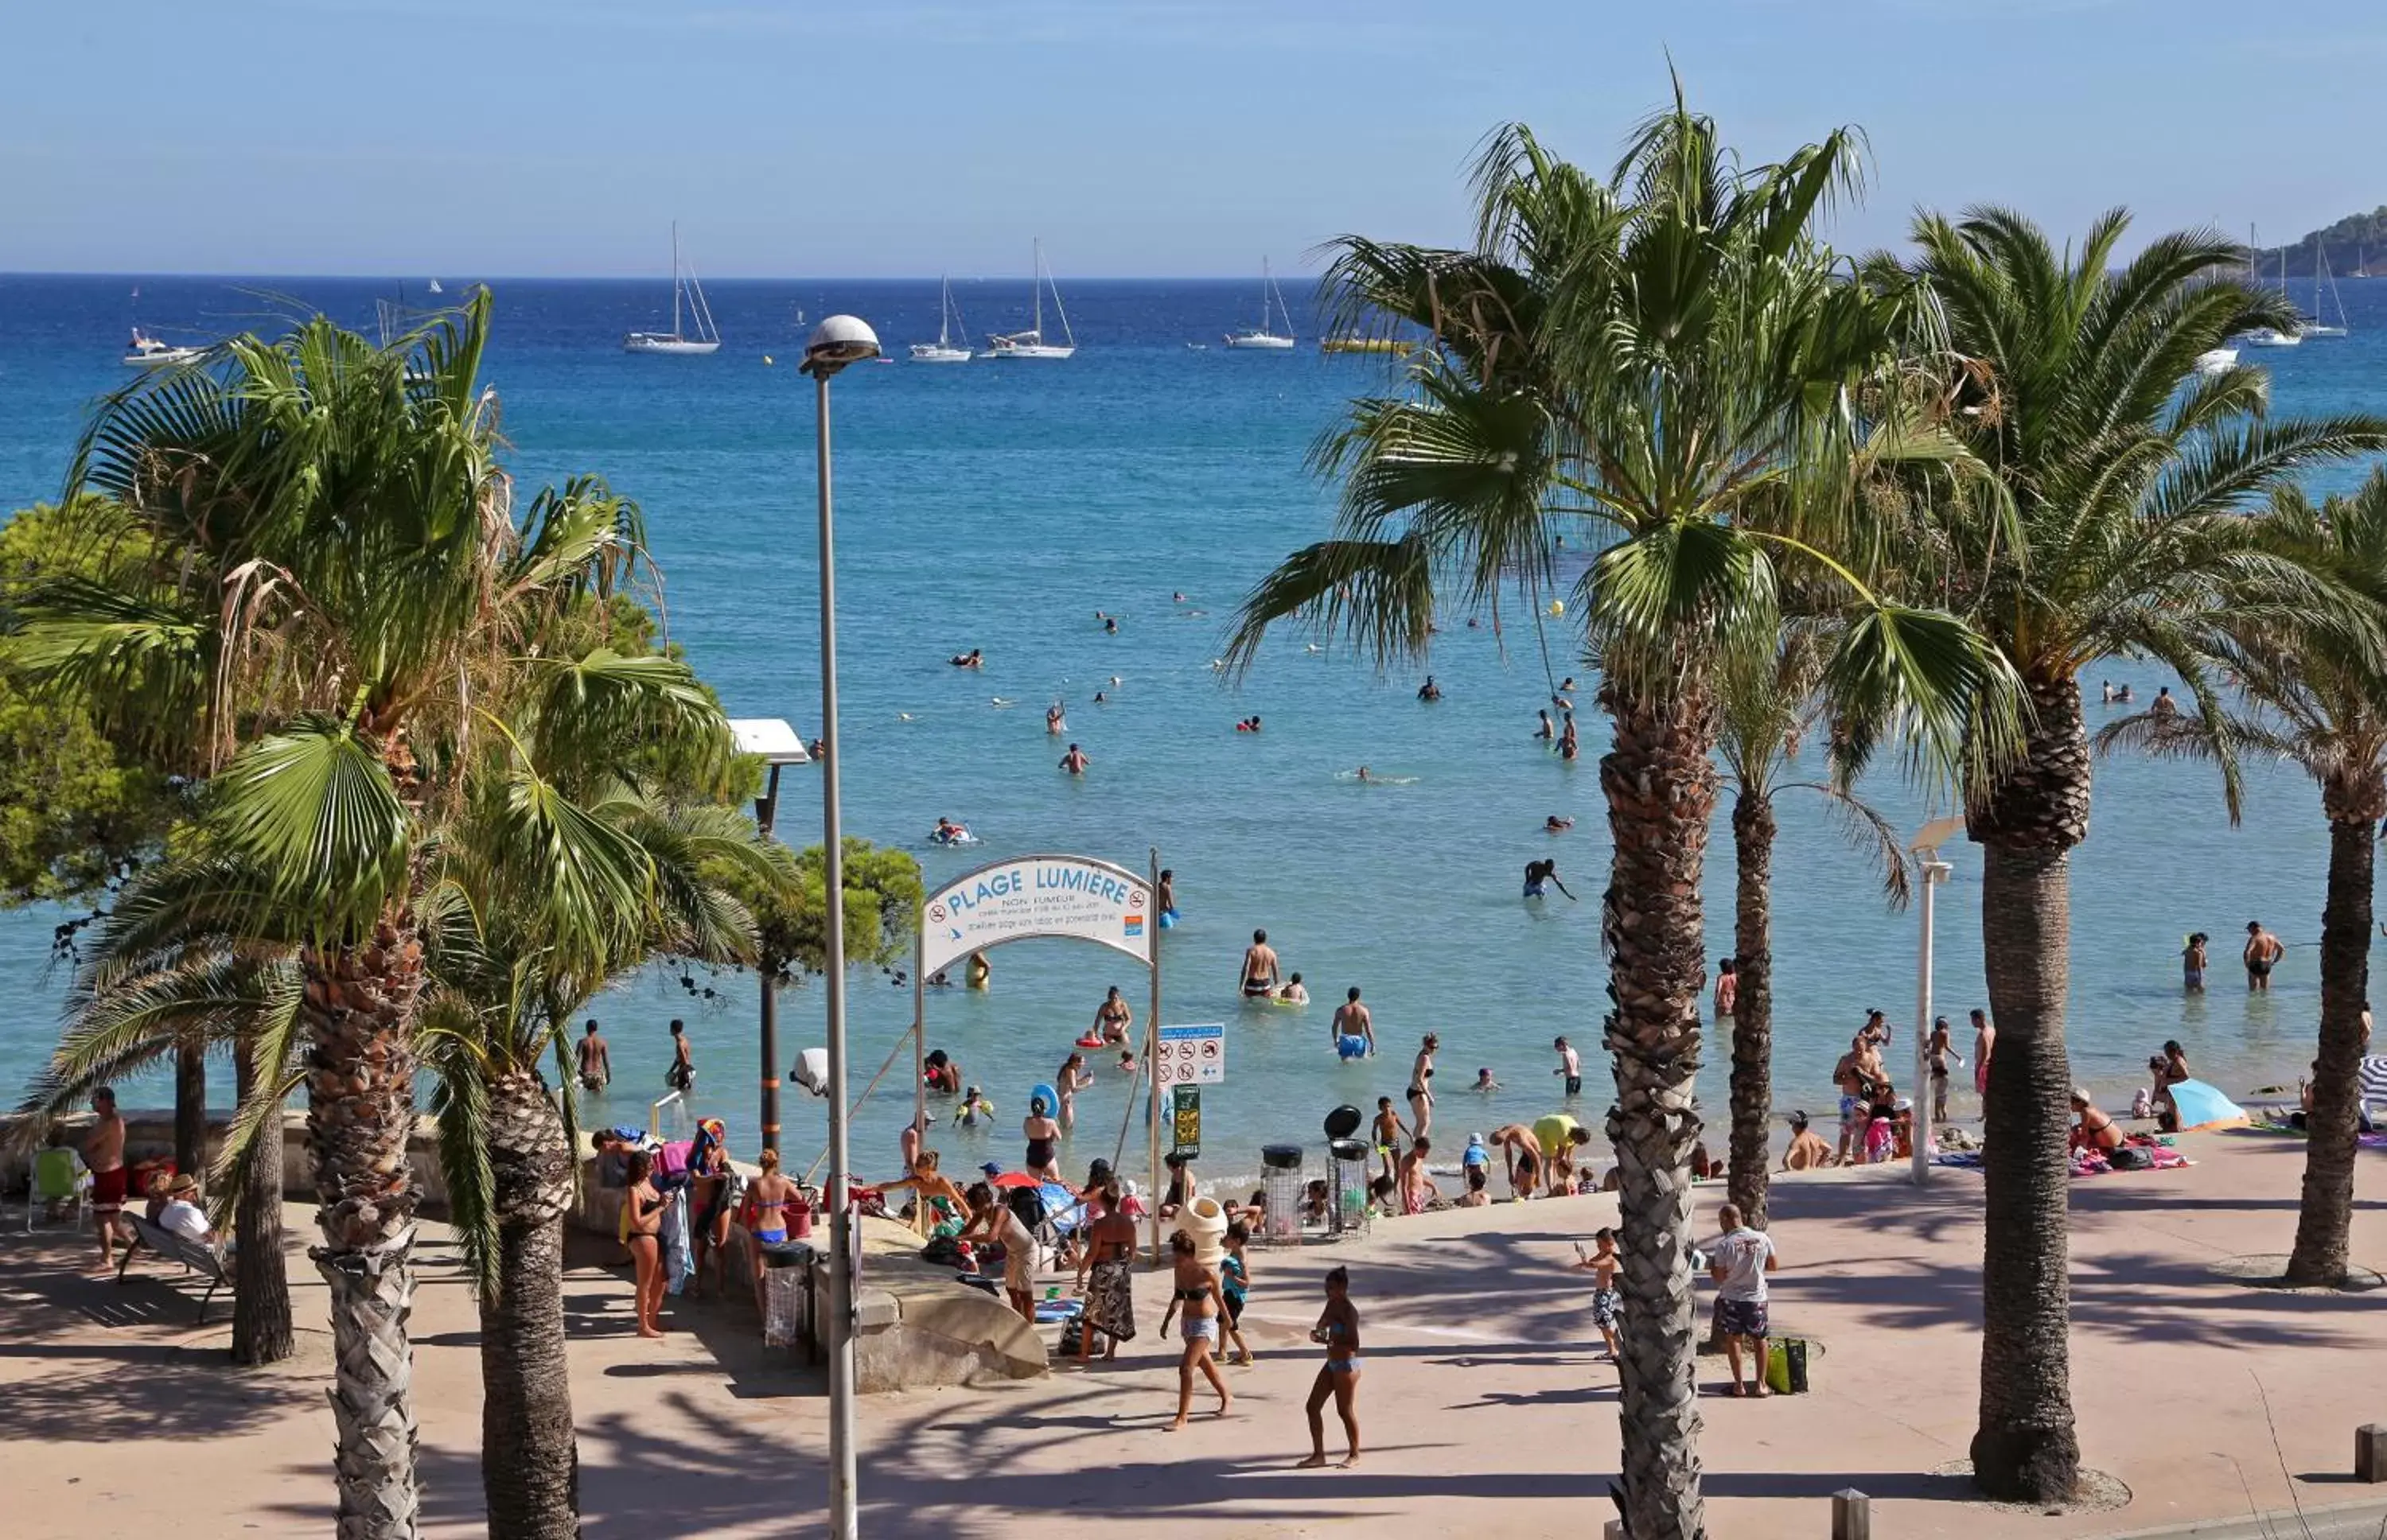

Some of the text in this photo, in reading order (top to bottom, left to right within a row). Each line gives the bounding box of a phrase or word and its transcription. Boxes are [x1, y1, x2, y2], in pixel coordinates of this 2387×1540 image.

[948, 871, 1022, 916] PLAGE
[1002, 895, 1075, 908] NON FUMEUR
